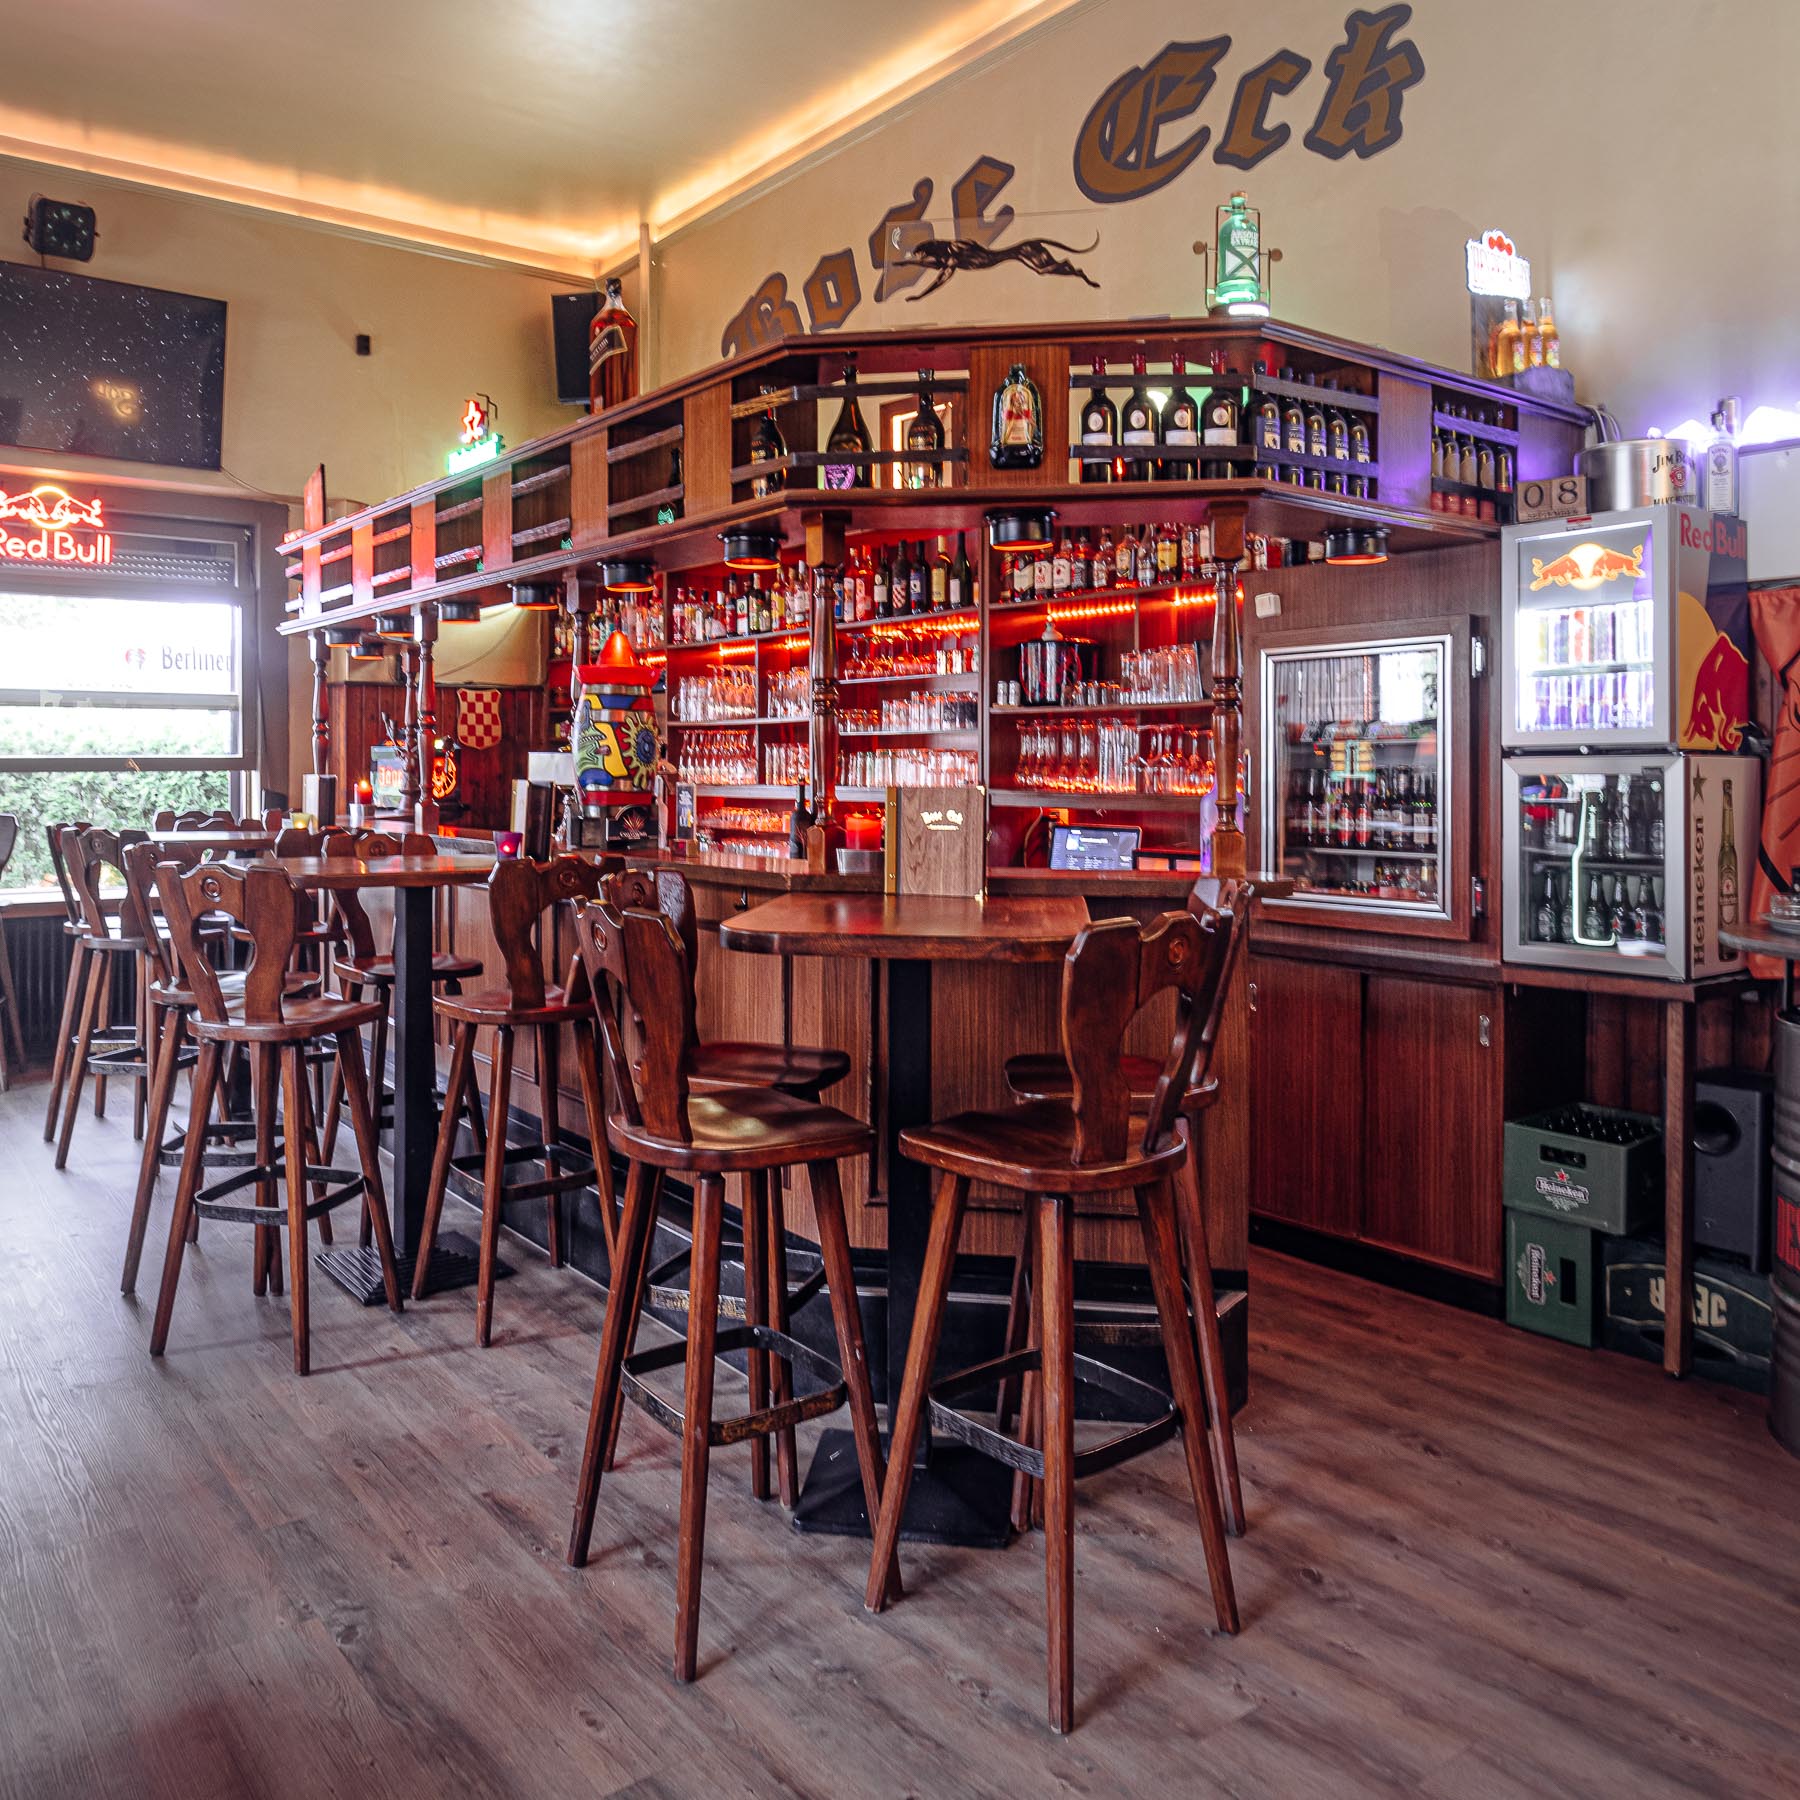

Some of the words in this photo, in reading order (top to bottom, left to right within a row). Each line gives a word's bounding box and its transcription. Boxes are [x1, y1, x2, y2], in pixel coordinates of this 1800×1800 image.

[1073, 4, 1425, 204] Eck
[54, 531, 111, 563] Bull
[1681, 513, 1713, 552] Red
[1715, 521, 1747, 560] Bull
[1693, 816, 1705, 967] Heineken
